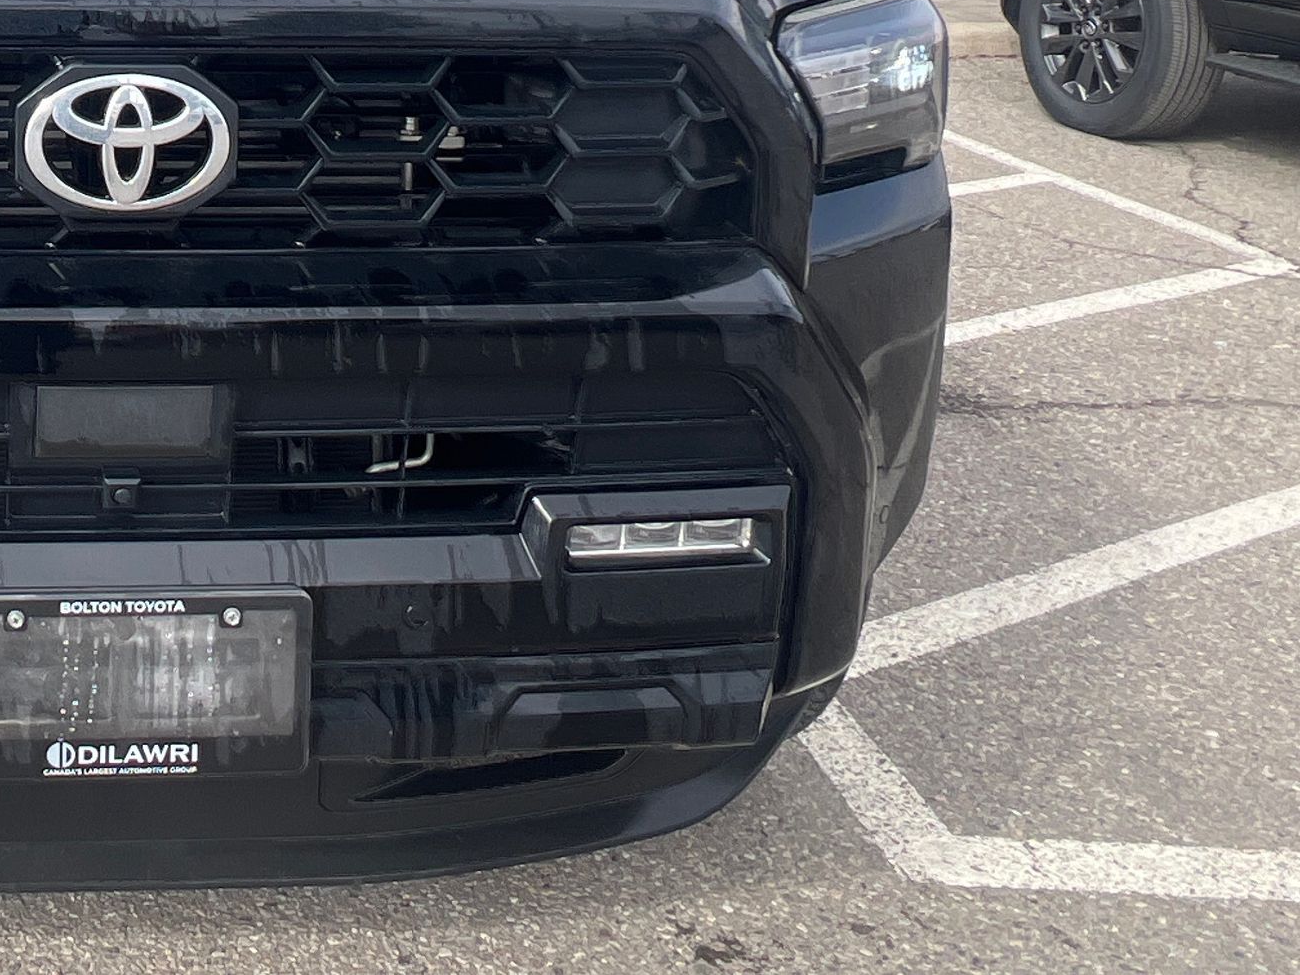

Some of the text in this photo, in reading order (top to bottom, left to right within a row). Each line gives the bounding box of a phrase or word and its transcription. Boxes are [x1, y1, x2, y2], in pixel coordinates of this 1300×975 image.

[60, 600, 186, 614] BOLTON TOYOTA
[78, 743, 198, 765] DILAWRI
[43, 765, 198, 776] CANADA'S LARGEST AUTOMOTIVE GROUP
